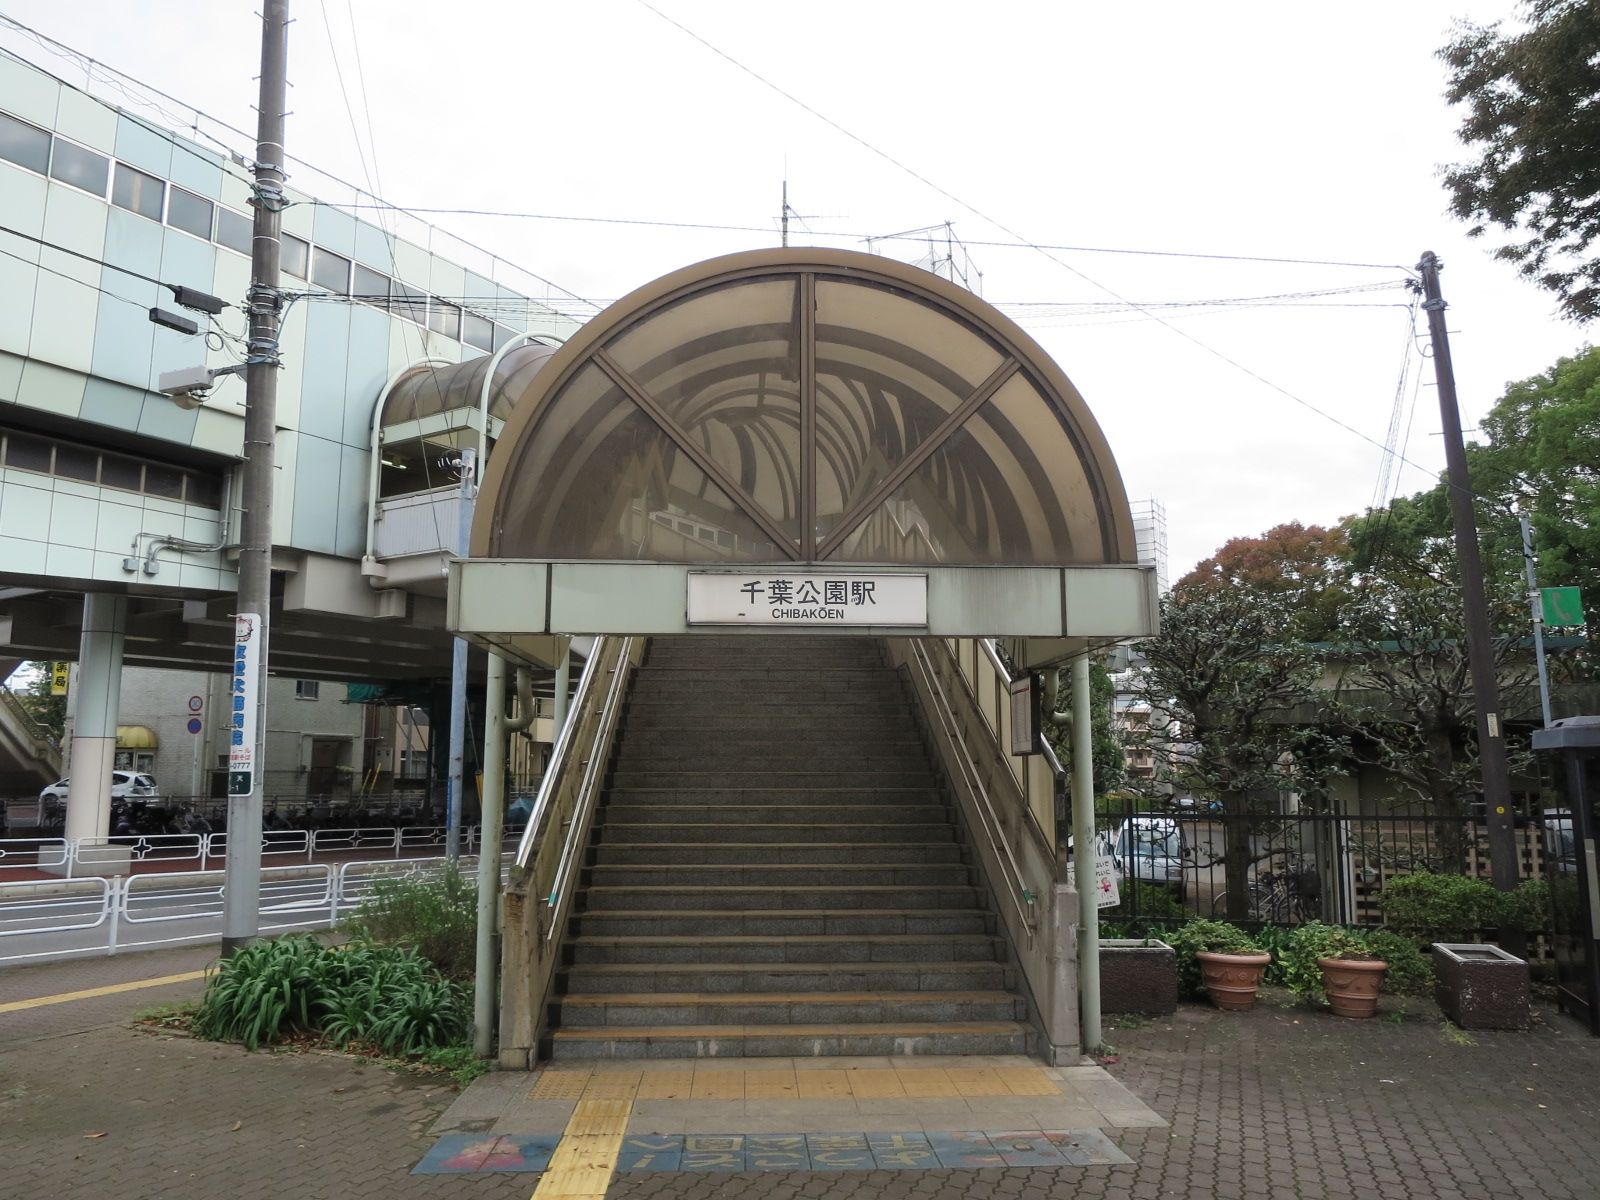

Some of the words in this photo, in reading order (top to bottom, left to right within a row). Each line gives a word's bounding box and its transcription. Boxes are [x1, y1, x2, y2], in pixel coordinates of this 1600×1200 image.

[740, 580, 876, 606] 千葉公園駅
